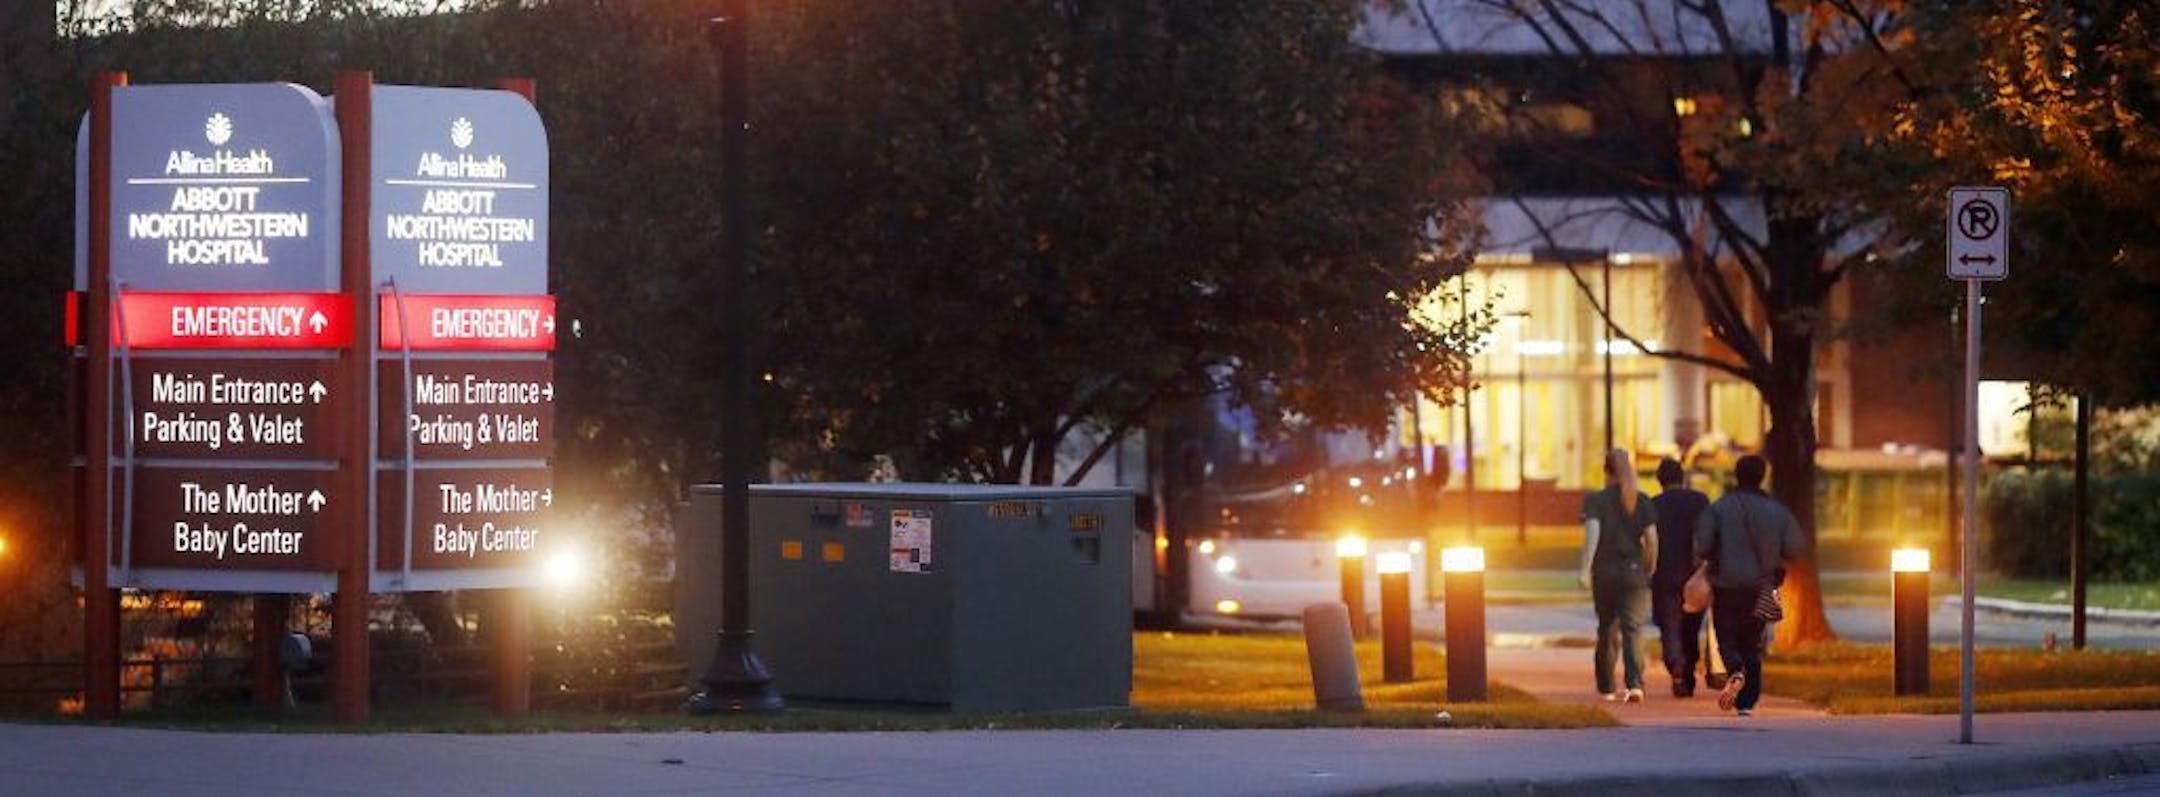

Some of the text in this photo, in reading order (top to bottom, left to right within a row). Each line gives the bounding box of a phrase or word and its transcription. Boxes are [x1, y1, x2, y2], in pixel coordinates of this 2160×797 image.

[171, 186, 260, 211] ABBOTT
[422, 190, 495, 214] ABBOTT
[129, 212, 308, 238] NORTHWESTERN
[387, 216, 534, 241] NORTHWESTERN
[167, 239, 269, 264] HOSPITAL
[419, 242, 503, 266] HOSPITAL
[171, 306, 304, 337] EMERGENCY
[432, 308, 540, 338] EMERGENCY
[152, 373, 304, 404] Main Entrance
[416, 374, 540, 404] Main Entrance
[143, 411, 304, 449] Parking & Valet
[410, 413, 539, 450] Parking & Valet
[180, 481, 303, 514] The Mother
[439, 483, 538, 513] The Mother
[174, 522, 303, 560] Baby Center
[434, 522, 538, 558] Baby Center
